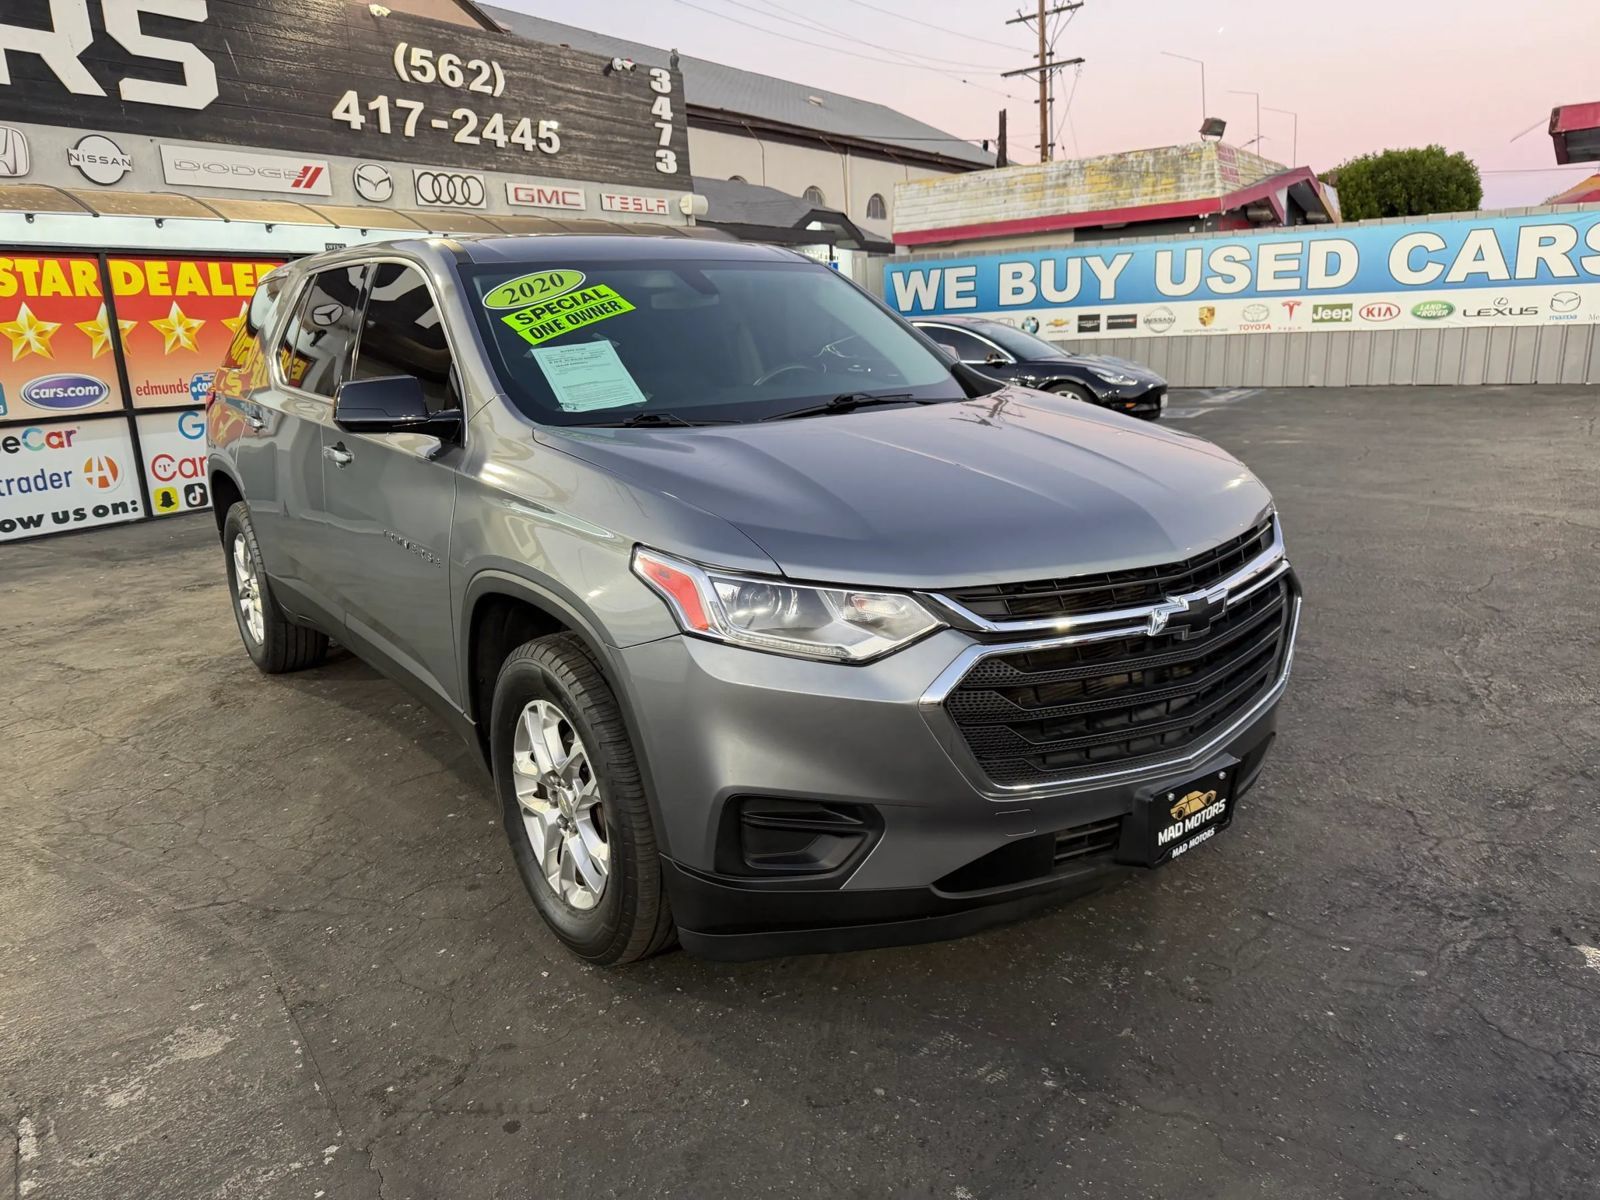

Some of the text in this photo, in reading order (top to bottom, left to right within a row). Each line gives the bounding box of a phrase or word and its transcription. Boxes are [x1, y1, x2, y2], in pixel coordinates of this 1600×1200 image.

[394, 42, 506, 97] (562)
[332, 90, 561, 154] 417-2445
[69, 152, 132, 167] NISSAN
[174, 158, 307, 180] DODGE
[513, 186, 581, 206] GMC
[606, 195, 666, 213] TESLA
[0, 258, 103, 297] STAR
[892, 265, 978, 312] WE
[998, 251, 1134, 307] BUY
[1154, 237, 1360, 299] USED
[502, 272, 564, 305] 2020
[514, 288, 609, 326] SPECIAL
[529, 299, 623, 340] ONE OWNER
[1313, 308, 1352, 321] Jeep
[1366, 307, 1393, 318] KIA
[1463, 307, 1538, 317] LEXUS
[30, 384, 100, 400] cars.com
[136, 377, 189, 396] edmunds
[51, 507, 87, 525] us
[92, 499, 139, 518] on:
[1158, 798, 1226, 846] MAD MOTORS
[1172, 827, 1215, 858] MAD MOTORS
